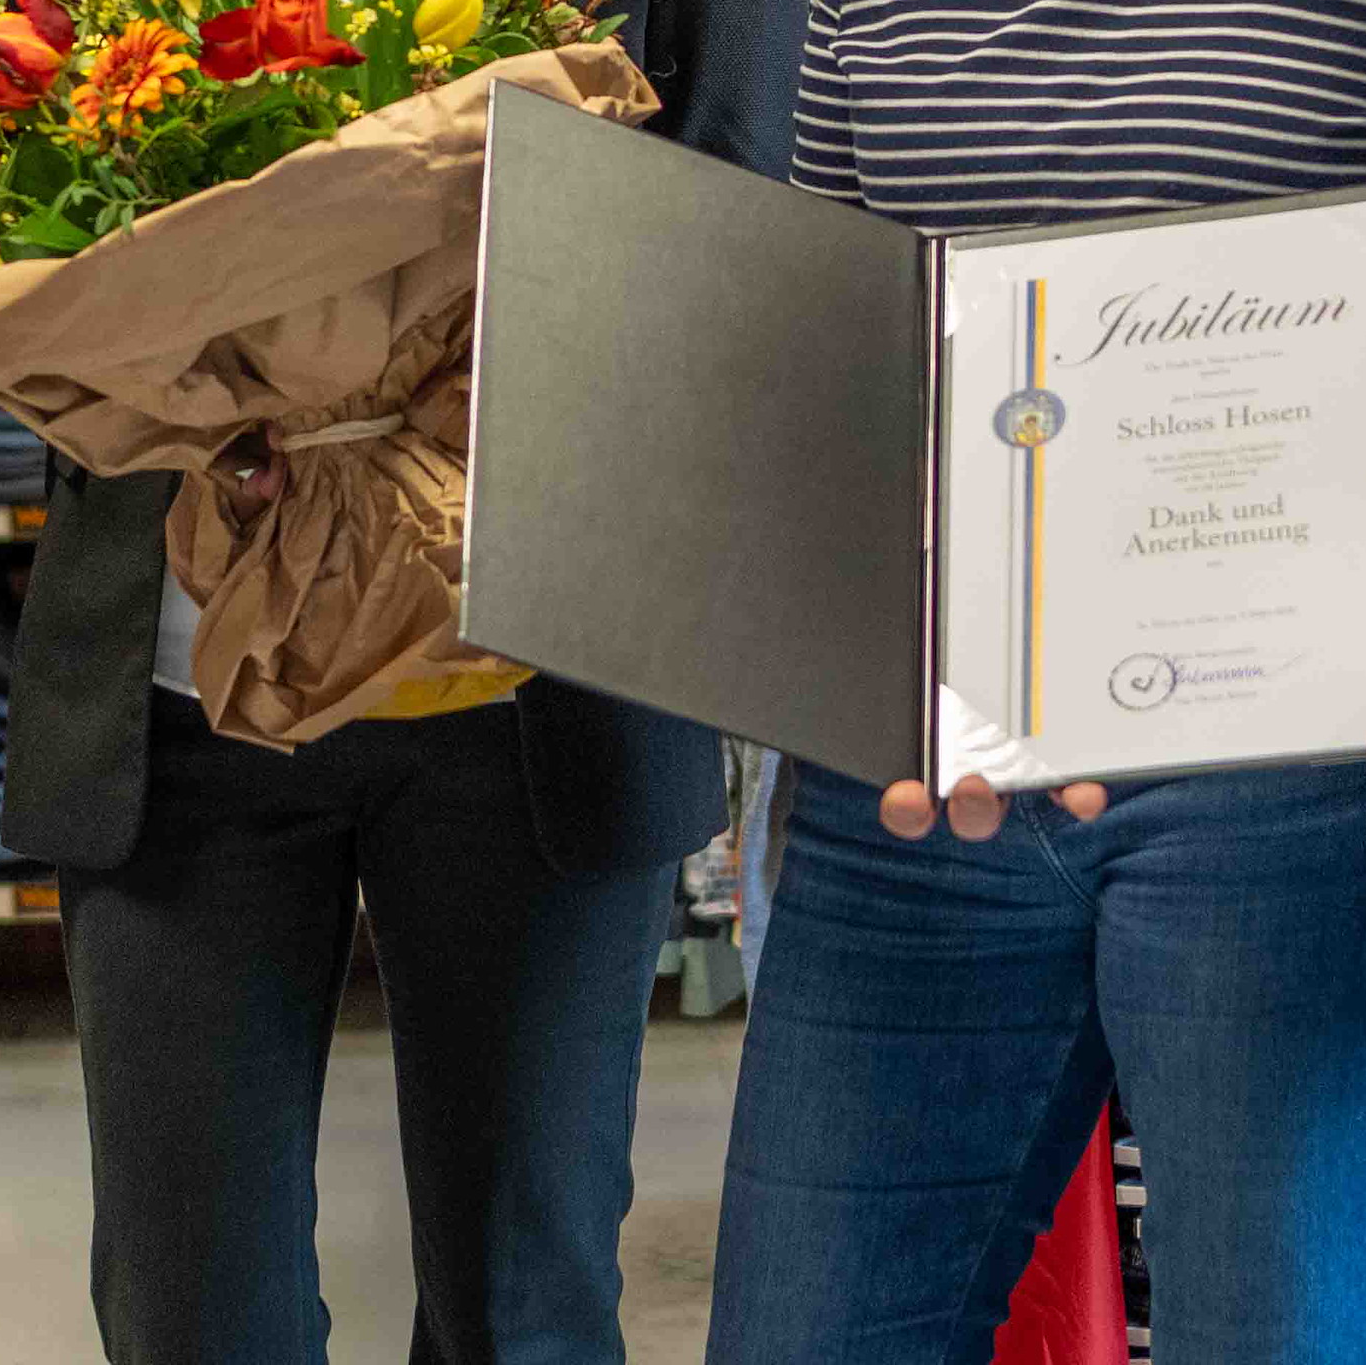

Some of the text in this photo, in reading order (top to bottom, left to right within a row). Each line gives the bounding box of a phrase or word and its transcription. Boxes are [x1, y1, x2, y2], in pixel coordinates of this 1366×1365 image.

[1054, 282, 1349, 368] Jubiläum
[1116, 404, 1312, 441] Schloss Hosen
[1147, 493, 1285, 530] Dank und
[1122, 522, 1311, 557] Anerkennung
